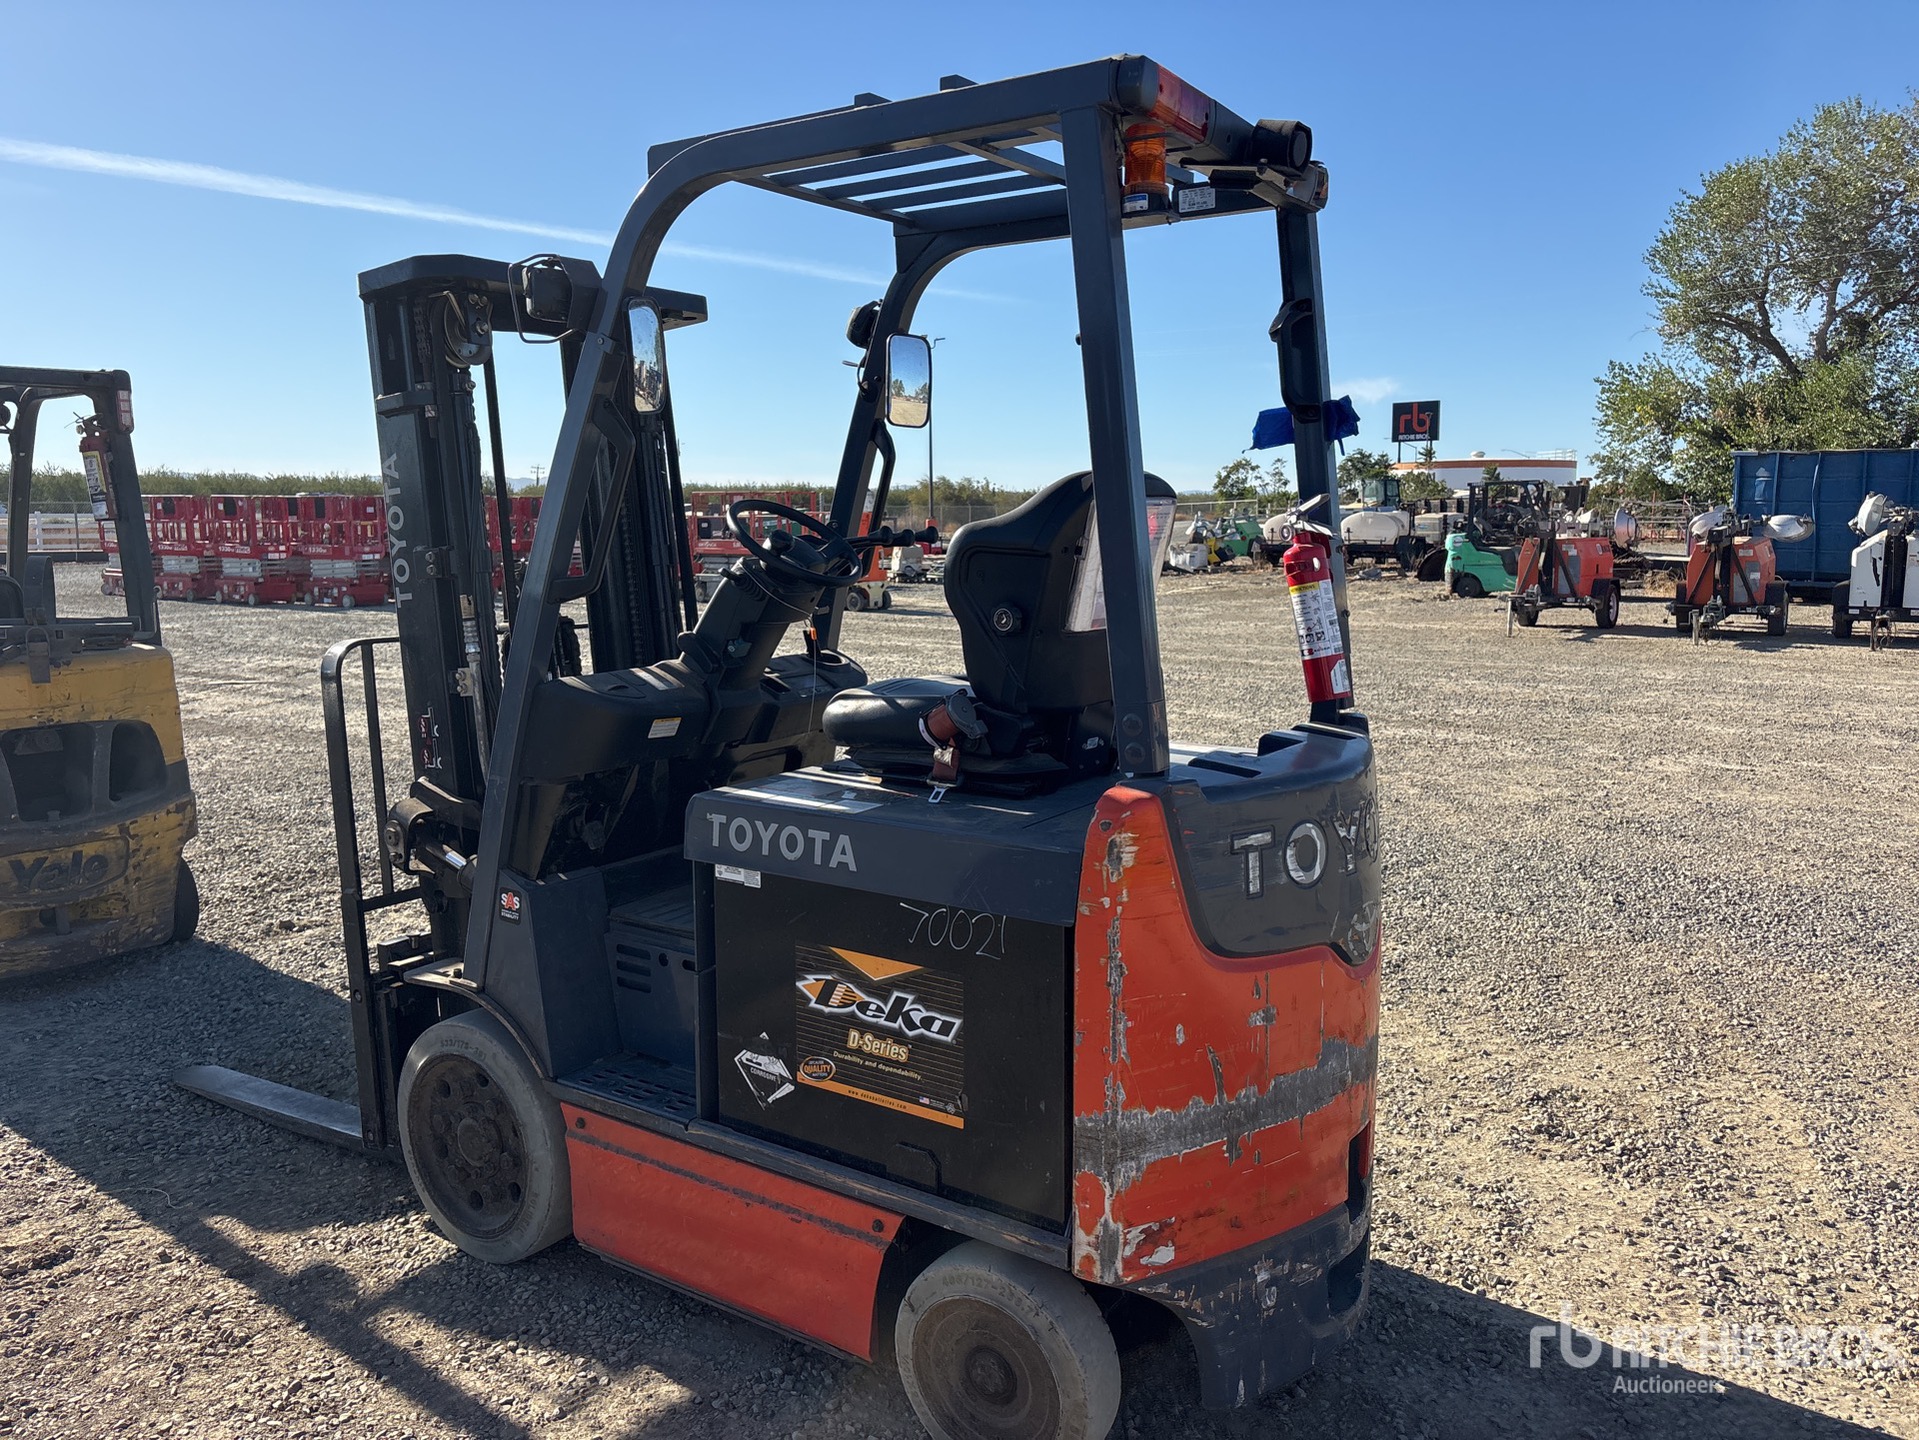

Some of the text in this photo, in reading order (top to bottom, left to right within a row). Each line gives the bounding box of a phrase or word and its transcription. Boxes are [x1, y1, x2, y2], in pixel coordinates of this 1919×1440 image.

[1399, 403, 1430, 433] rb
[382, 453, 413, 608] TOYOTA
[708, 813, 857, 872] TOYOTA
[8, 850, 109, 893] Yale
[500, 892, 520, 911] SAS
[899, 902, 1007, 961] 70021
[797, 974, 964, 1042] Deka
[803, 1064, 831, 1074] QUALITY
[833, 1050, 864, 1066] Durability
[864, 1057, 877, 1068] and
